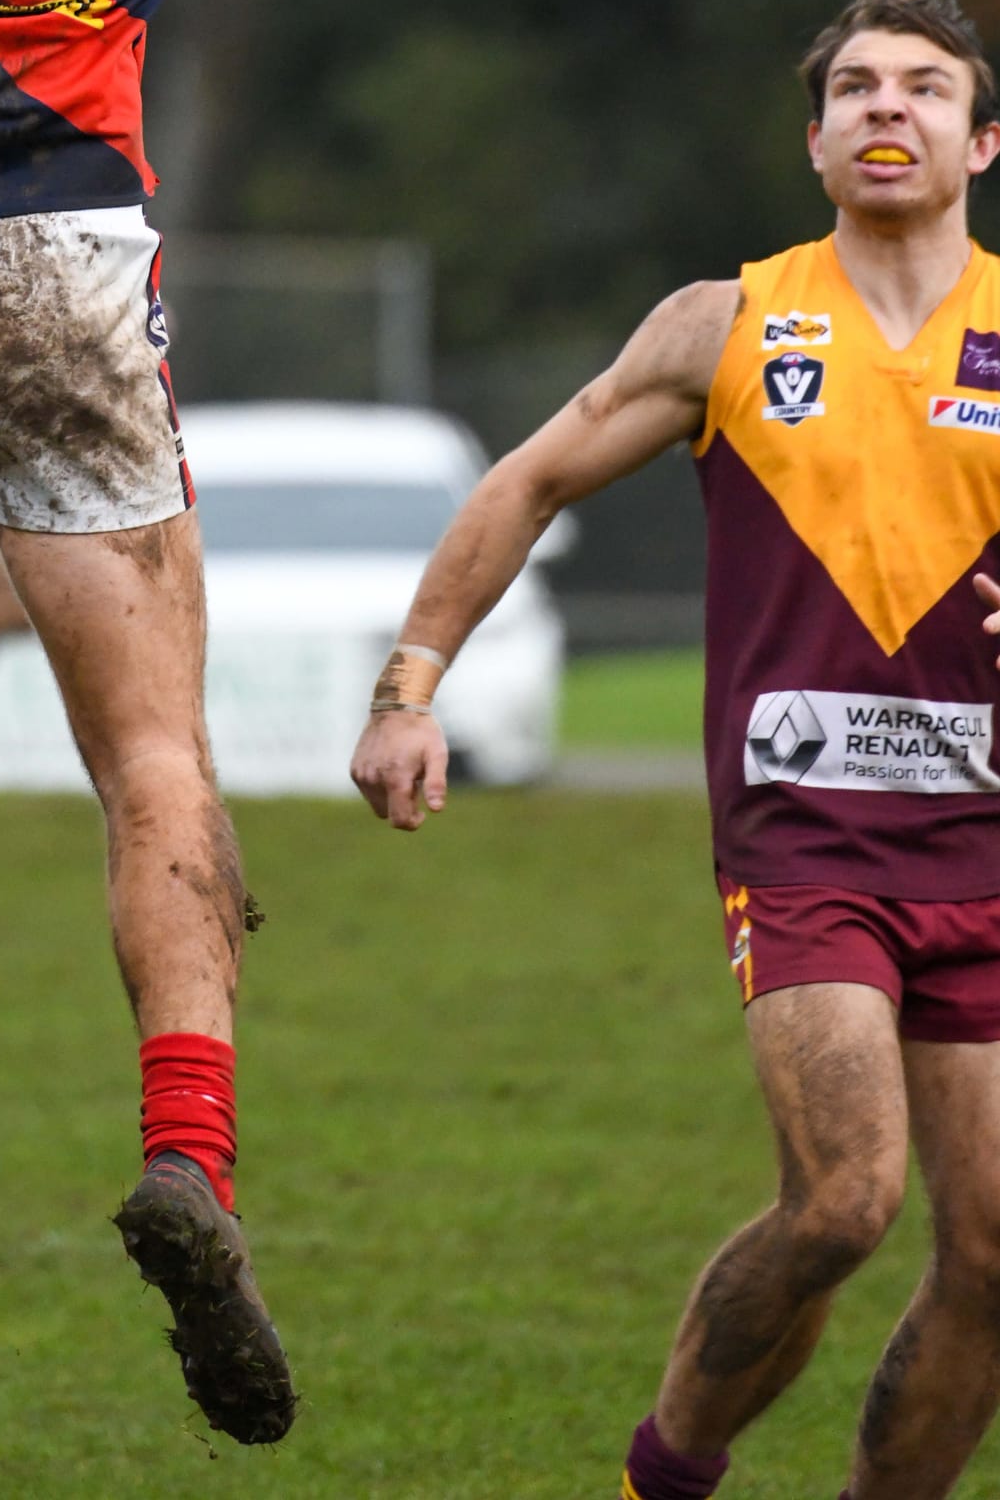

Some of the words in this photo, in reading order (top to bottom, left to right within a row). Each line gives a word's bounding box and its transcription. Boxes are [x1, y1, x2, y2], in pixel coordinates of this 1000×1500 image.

[957, 402, 1000, 428] Uni
[846, 706, 986, 737] WARRAGUL
[846, 734, 969, 762] RENAULT
[843, 761, 917, 780] Passion
[922, 764, 947, 780] for
